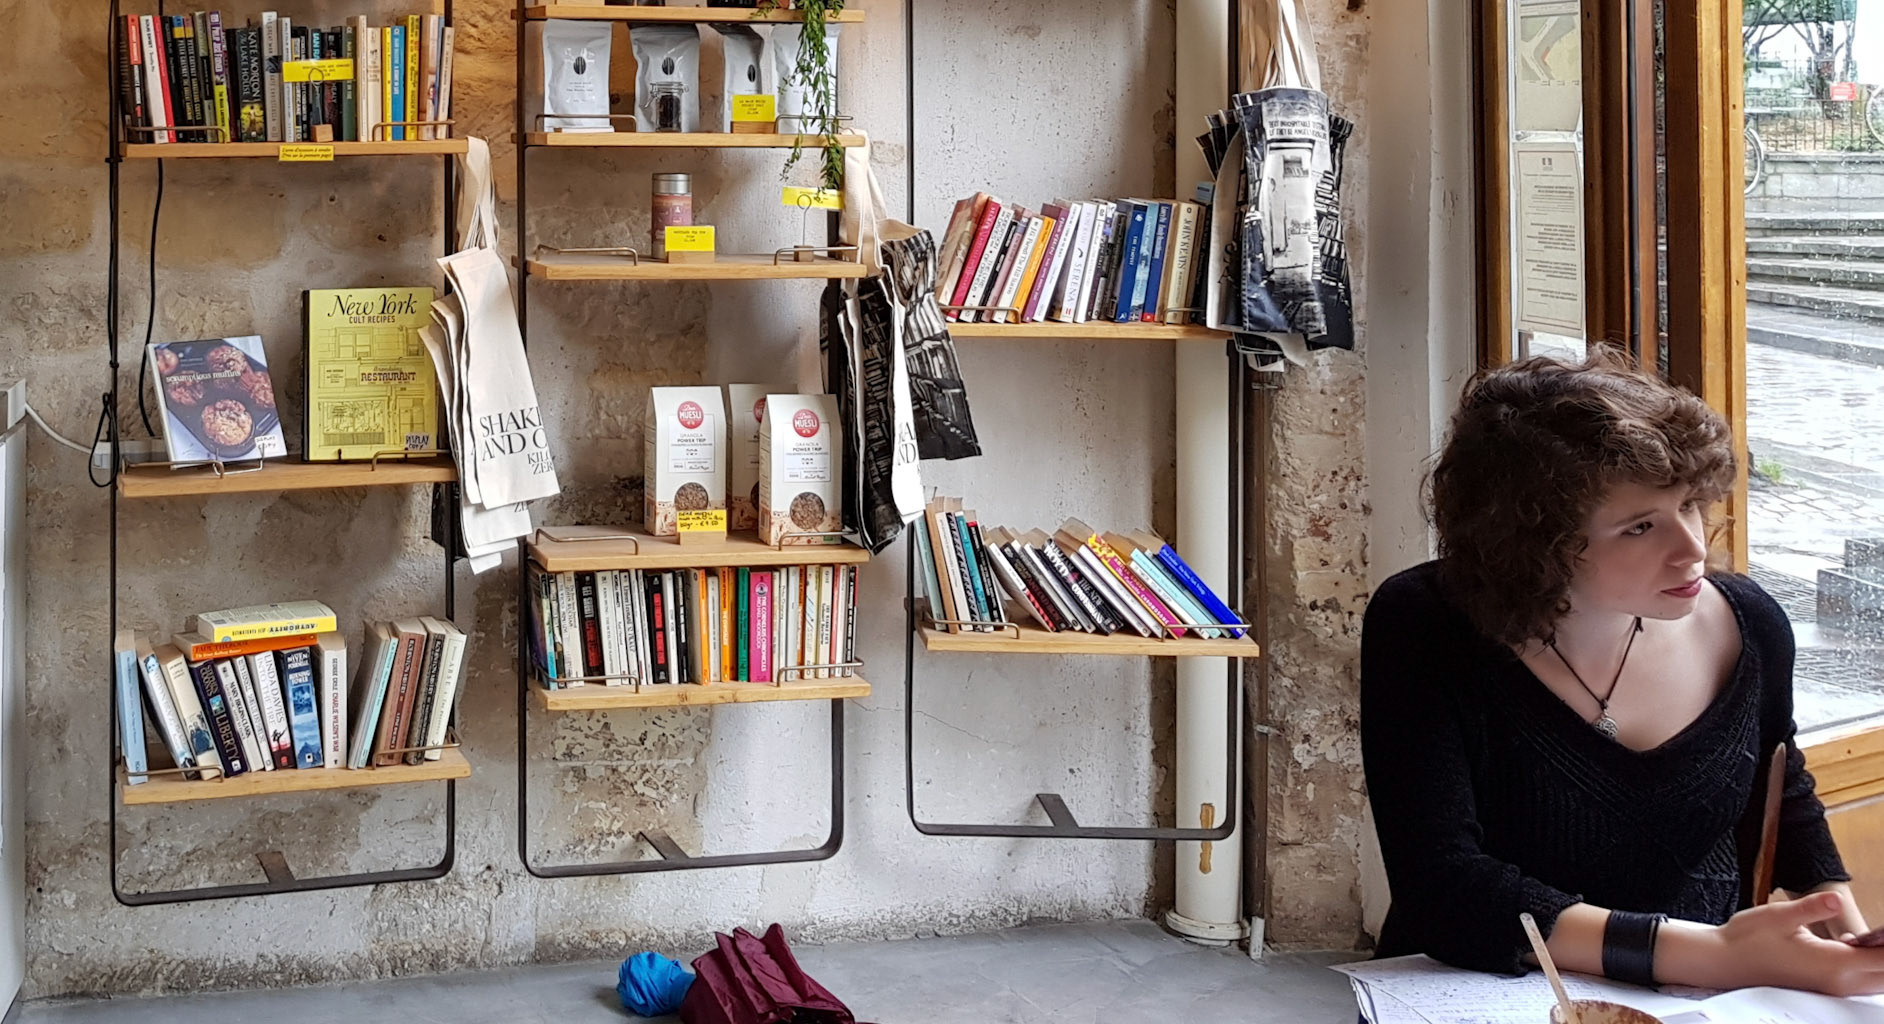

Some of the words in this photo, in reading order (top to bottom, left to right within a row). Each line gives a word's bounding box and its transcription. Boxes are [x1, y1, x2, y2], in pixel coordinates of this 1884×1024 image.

[211, 26, 221, 42] PHILIP
[248, 31, 259, 54] KATE
[312, 32, 320, 47] IAN
[177, 39, 186, 55] PETER
[186, 39, 195, 55] PETER
[240, 45, 250, 65] LAKE
[241, 67, 251, 96] HOUSE
[250, 56, 261, 97] MORTON
[1181, 217, 1192, 240] JOHN
[983, 259, 993, 272] THE
[1017, 254, 1026, 266] The
[1176, 240, 1189, 270] KEATS
[1066, 261, 1081, 303] SERENA
[327, 294, 374, 318] New
[378, 293, 418, 316] York
[349, 316, 366, 325] CULT
[367, 315, 396, 324] RECIPES
[165, 372, 212, 385] scrumptious
[212, 369, 242, 379] muffins
[360, 371, 417, 382] RESTAURANT
[679, 410, 702, 420] MUESLI
[794, 418, 818, 428] MUESLI
[405, 434, 430, 445] DISPLAY
[482, 432, 527, 462] AND
[1041, 543, 1070, 578] BOYD
[582, 585, 593, 597] GET
[1077, 576, 1092, 592] THE
[582, 596, 594, 618] SHORTY
[623, 603, 632, 625] Leonard
[1139, 592, 1170, 625] CHROMOSOME
[254, 656, 269, 684] INTO
[262, 653, 278, 686] LINDA
[444, 661, 454, 686] ABSE
[399, 672, 408, 694] MISTRY
[427, 673, 435, 695] MISTRY
[261, 687, 273, 704] THE
[268, 686, 286, 724] DAVIES
[228, 680, 240, 699] MARY
[240, 717, 252, 739] CLARK
[265, 705, 277, 726] FIRE
[213, 712, 241, 762] LIBERTY
